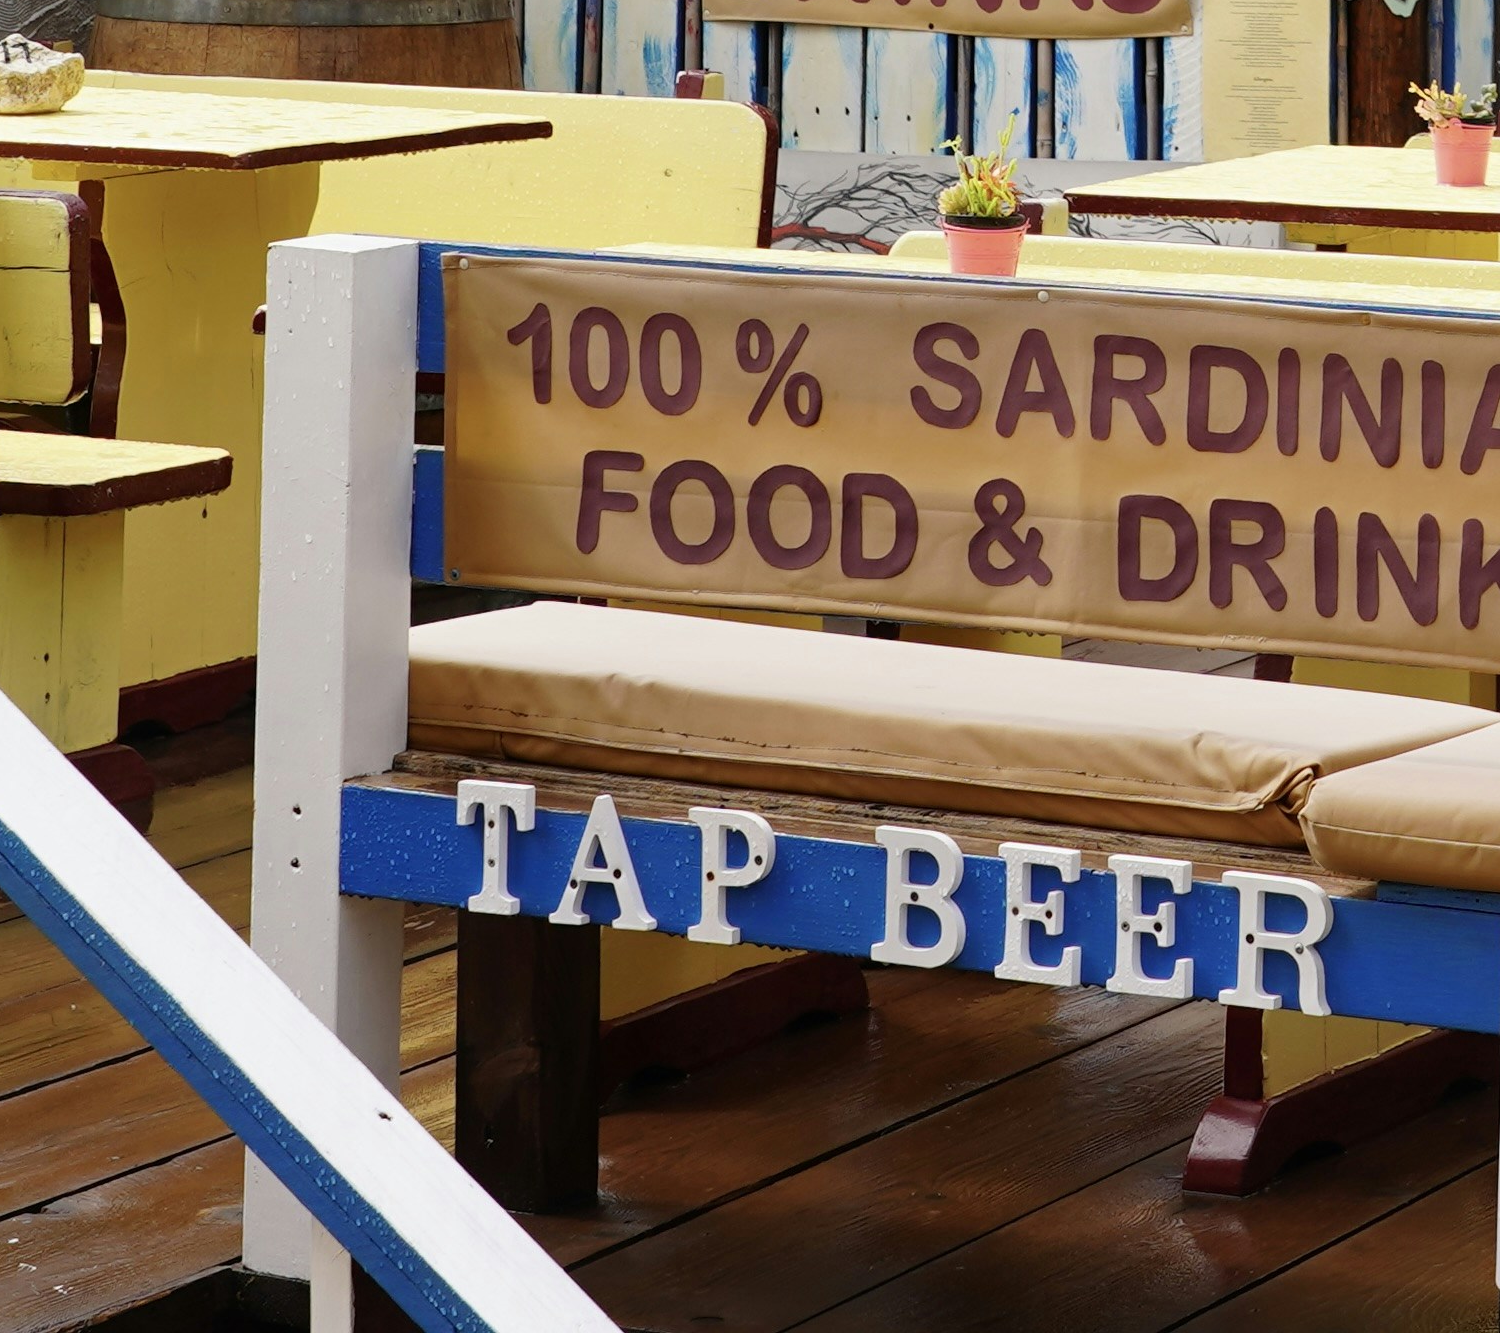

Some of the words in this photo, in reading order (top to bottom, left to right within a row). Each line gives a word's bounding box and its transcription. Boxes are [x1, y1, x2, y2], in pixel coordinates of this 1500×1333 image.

[507, 302, 701, 416] 100
[575, 450, 919, 580] FOOD
[967, 478, 1054, 587] &
[455, 778, 776, 945] TAP
[871, 824, 1333, 1017] BEER
